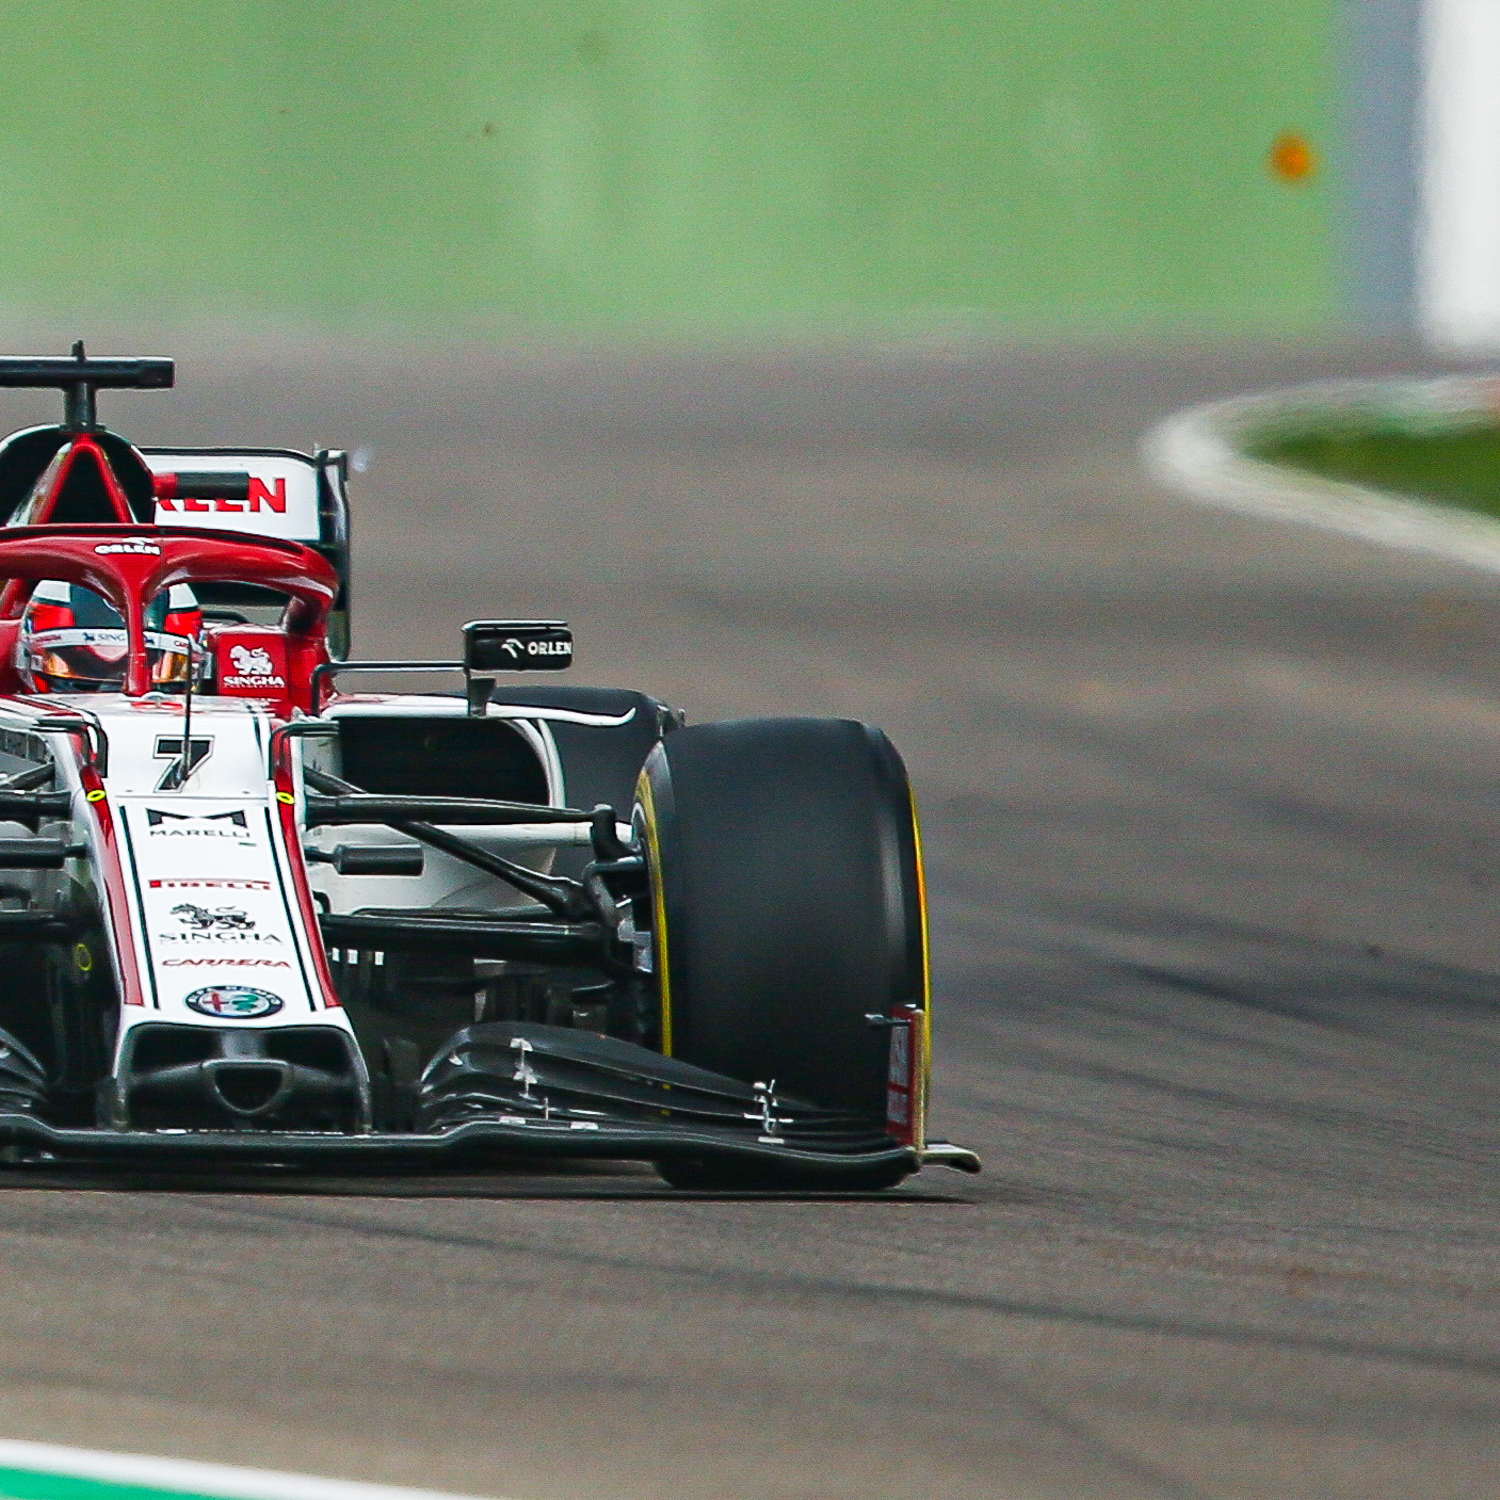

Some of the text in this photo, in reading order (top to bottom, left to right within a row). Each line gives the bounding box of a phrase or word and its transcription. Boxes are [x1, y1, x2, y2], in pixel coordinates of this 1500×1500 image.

[98, 634, 127, 642] SING
[527, 641, 573, 656] ORLEN
[223, 676, 285, 686] SINGHA
[153, 734, 215, 793] 7
[149, 828, 251, 839] MARELLI
[158, 931, 283, 944] SINGHA
[161, 958, 292, 970] CARRERA
